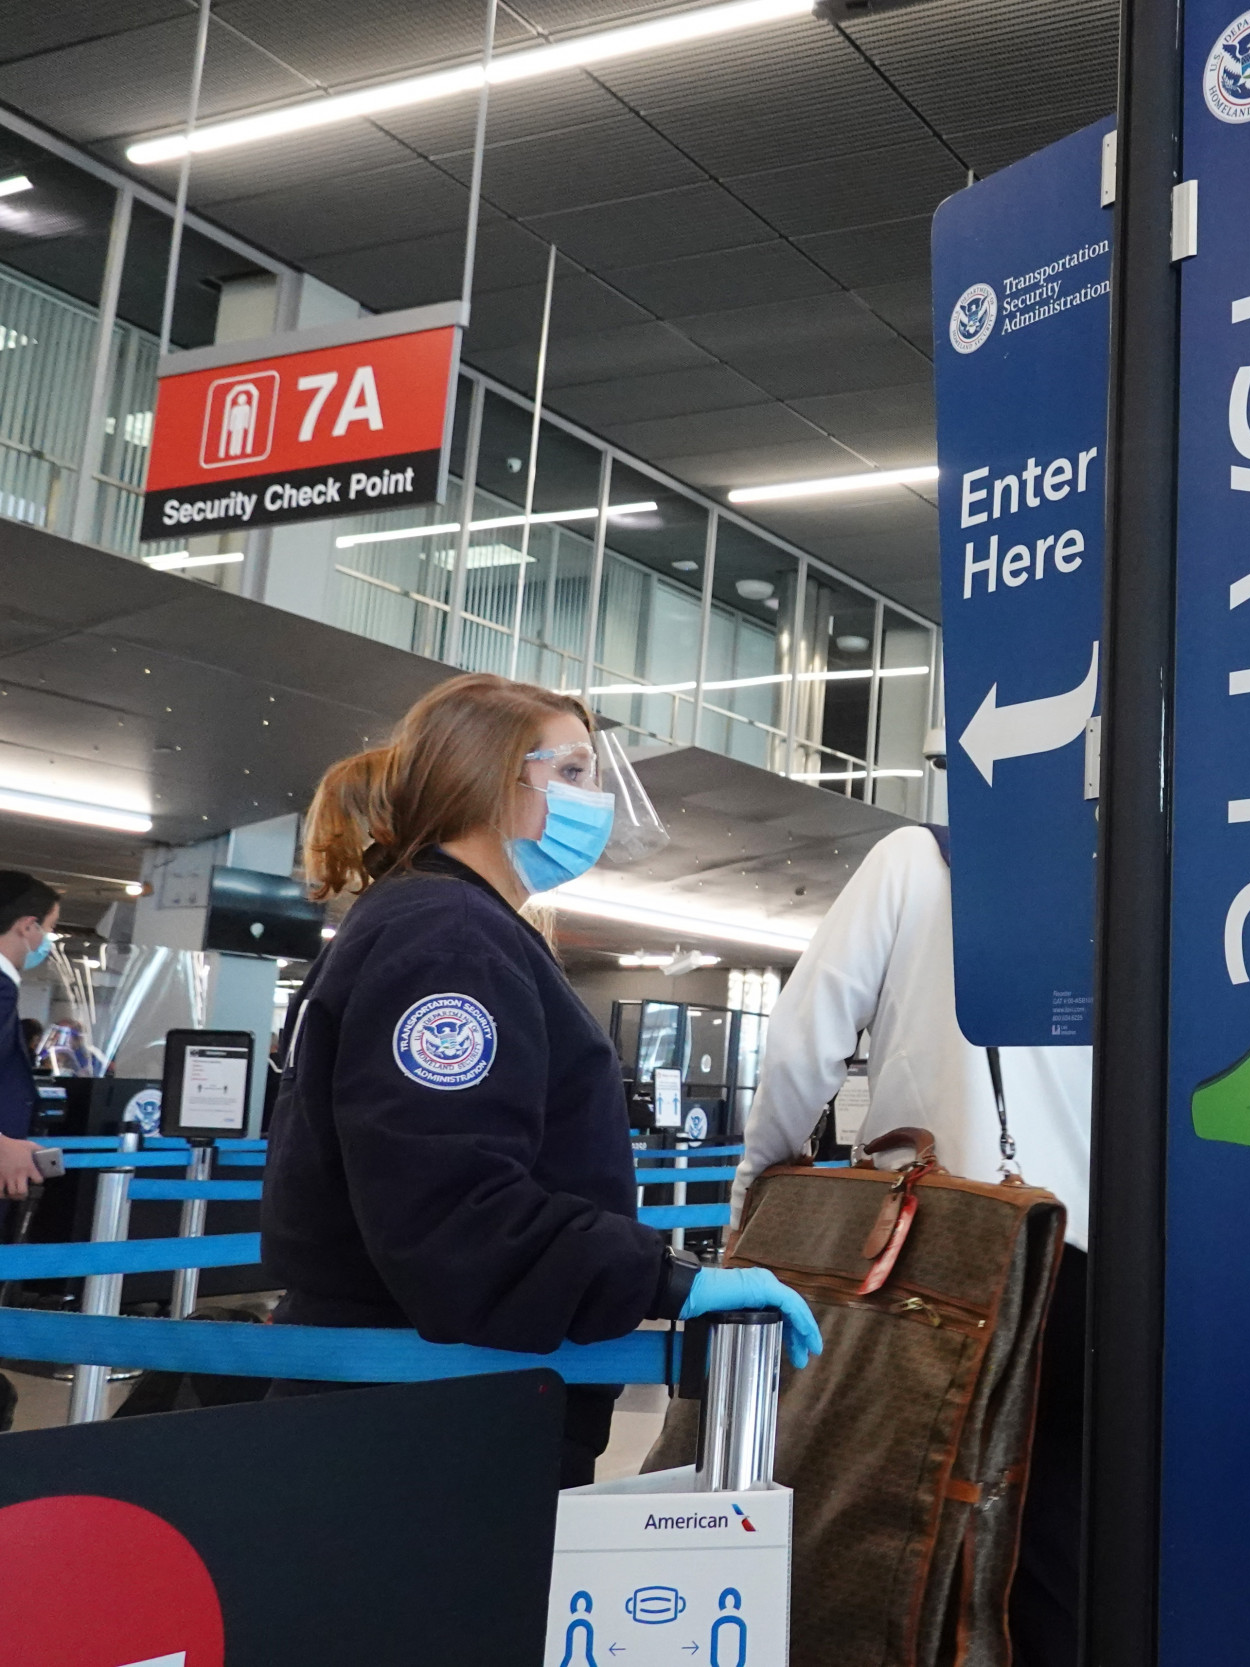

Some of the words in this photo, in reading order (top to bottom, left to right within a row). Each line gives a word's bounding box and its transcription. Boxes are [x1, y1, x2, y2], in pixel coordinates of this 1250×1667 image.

[1002, 239, 1110, 296] Transportation
[1001, 279, 1112, 336] Administration
[1002, 279, 1062, 316] Security
[296, 365, 384, 443] 7A
[162, 490, 258, 526] Security
[263, 476, 342, 512] Check
[349, 466, 415, 500] Point
[960, 446, 1098, 529] Enter
[963, 528, 1085, 600] Here
[401, 999, 463, 1053] TRANSPORTATION
[463, 1003, 492, 1040] SECURITY
[413, 1059, 487, 1083] ADMINISTRATION
[416, 1048, 455, 1071] HOMELAND
[643, 1512, 729, 1531] American
